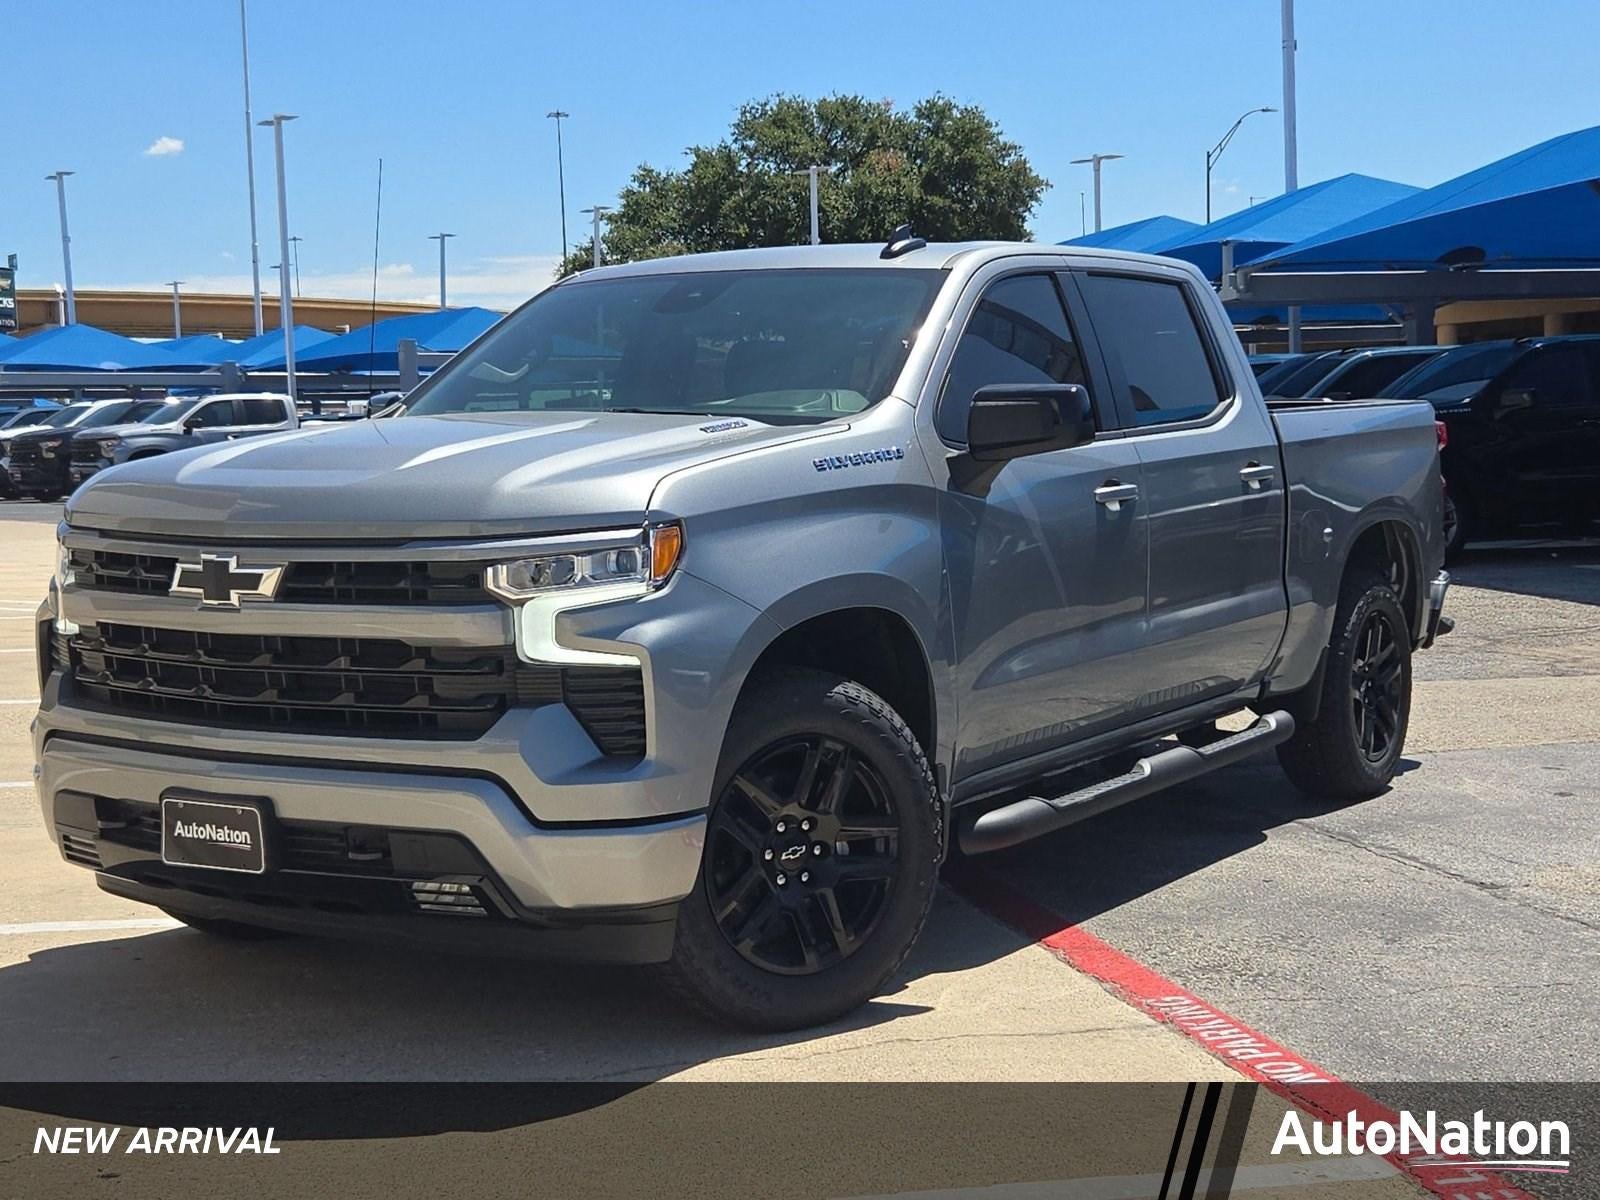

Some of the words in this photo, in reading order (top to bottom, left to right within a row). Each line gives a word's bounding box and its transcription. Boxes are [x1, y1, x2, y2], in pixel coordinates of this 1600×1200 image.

[813, 447, 905, 472] SILVERADO
[174, 820, 251, 844] AutoNation
[1143, 996, 1283, 1060] PARKING
